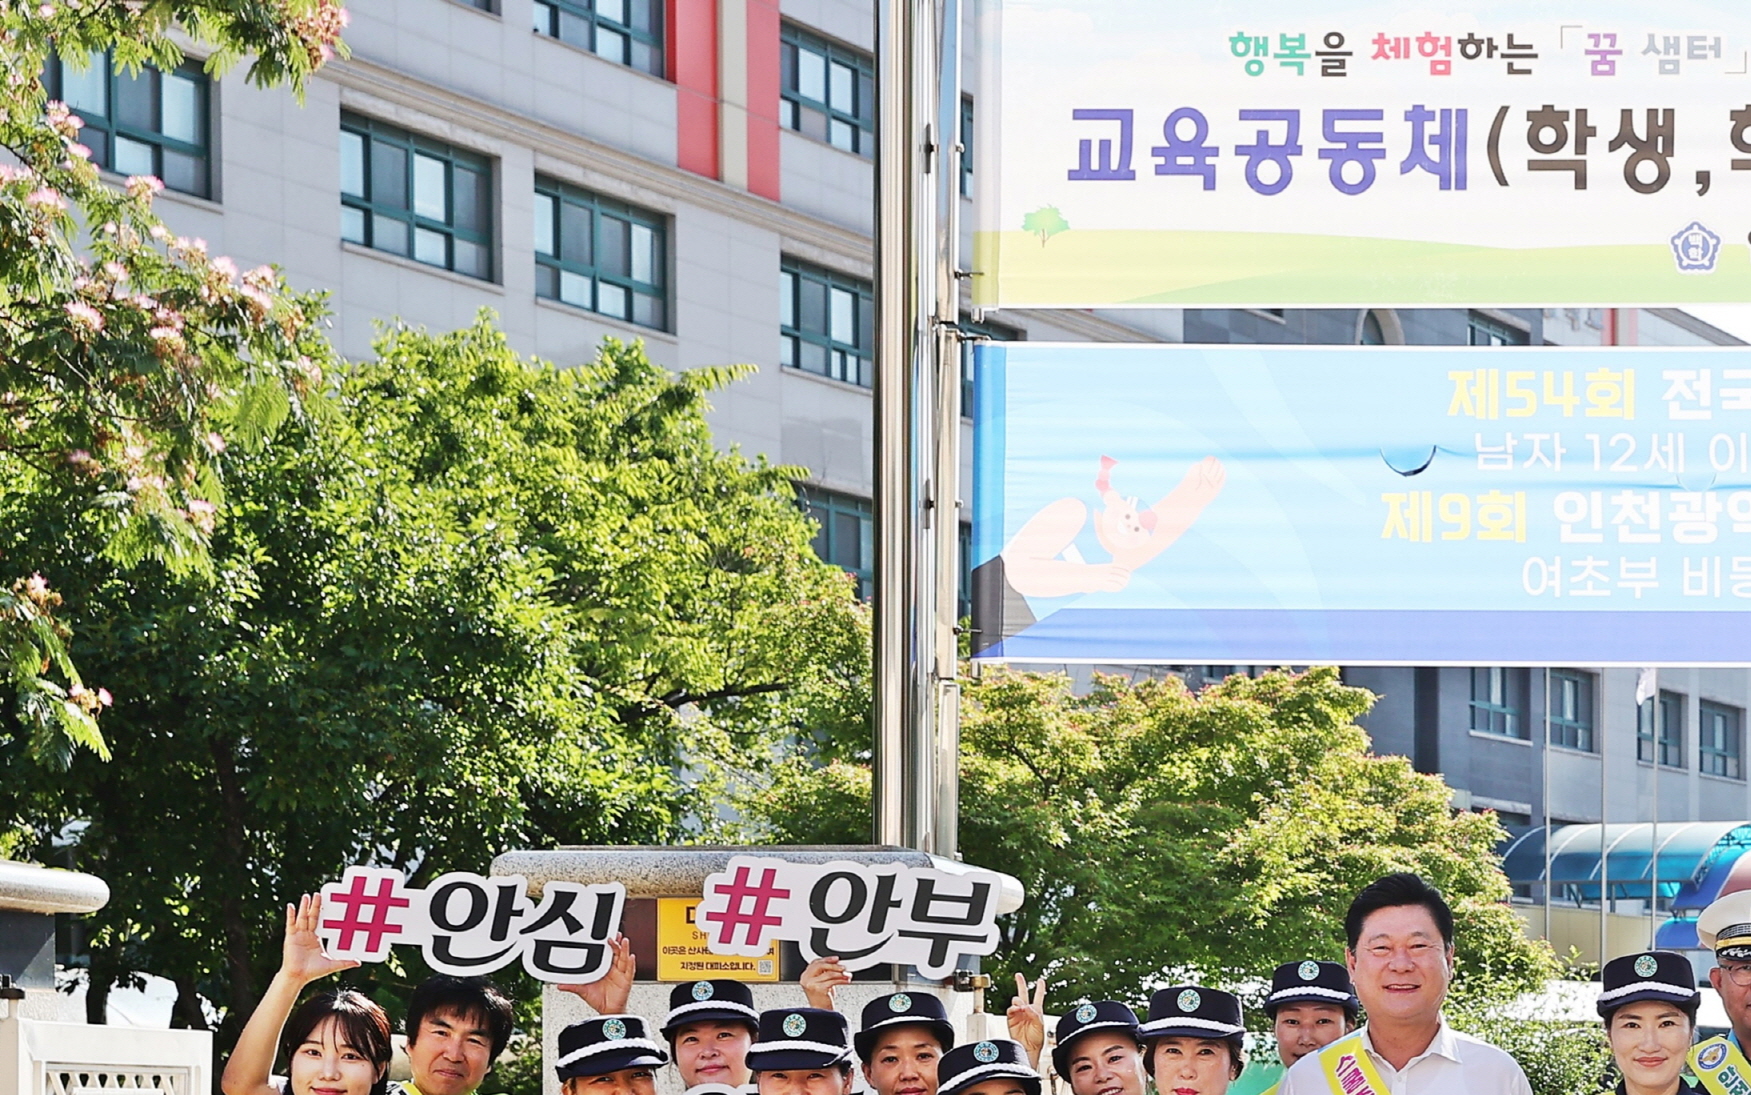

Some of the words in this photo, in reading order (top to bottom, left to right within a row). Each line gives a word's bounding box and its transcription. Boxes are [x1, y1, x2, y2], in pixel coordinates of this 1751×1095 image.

[1229, 30, 1353, 78] 행복을
[1370, 30, 1538, 77] 체험하는
[1447, 367, 1636, 420] 제54회
[1474, 431, 1566, 473] 남자
[1585, 431, 1686, 473] 12세
[1380, 490, 1527, 544] 제9회
[1522, 555, 1660, 600] 여초부
[322, 876, 617, 977] #안심
[704, 864, 990, 970] #안부
